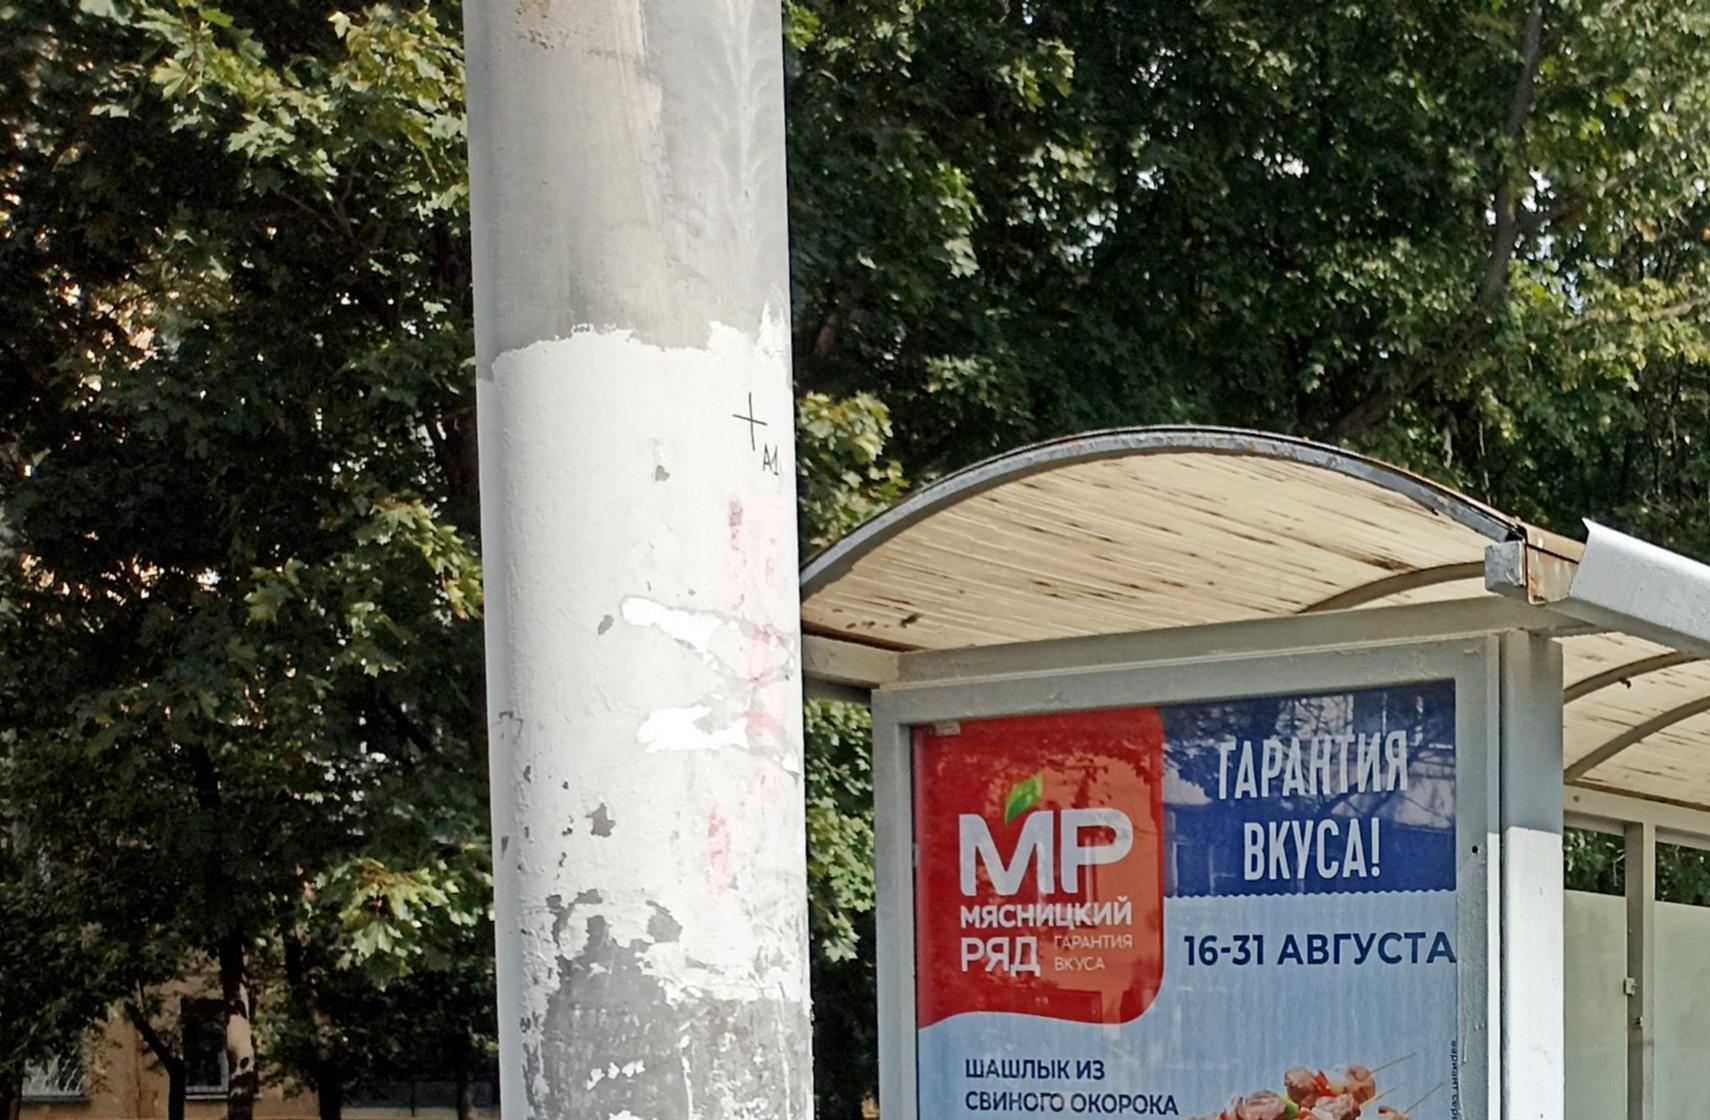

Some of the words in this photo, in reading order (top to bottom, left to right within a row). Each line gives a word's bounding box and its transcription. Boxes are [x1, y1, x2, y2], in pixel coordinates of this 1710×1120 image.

[1217, 730, 1408, 800] ГАРАНТИЯ
[959, 807, 1134, 897] МР
[1243, 817, 1381, 881] ВКУСА!
[960, 896, 1132, 930] МЯСНИЦКИЙ
[961, 936, 1041, 977] РЯД
[1054, 934, 1133, 950] ГАРАНТИЯ
[1184, 934, 1265, 966] 16-31
[1276, 931, 1457, 966] АВГУСТА
[1054, 956, 1105, 971] ВКУСА
[965, 1058, 1070, 1081] ШАШЛЫК
[1076, 1060, 1106, 1081] ИЗ
[965, 1091, 1066, 1113] СВИНОГО
[1070, 1094, 1179, 1117] ОКОРОКА
